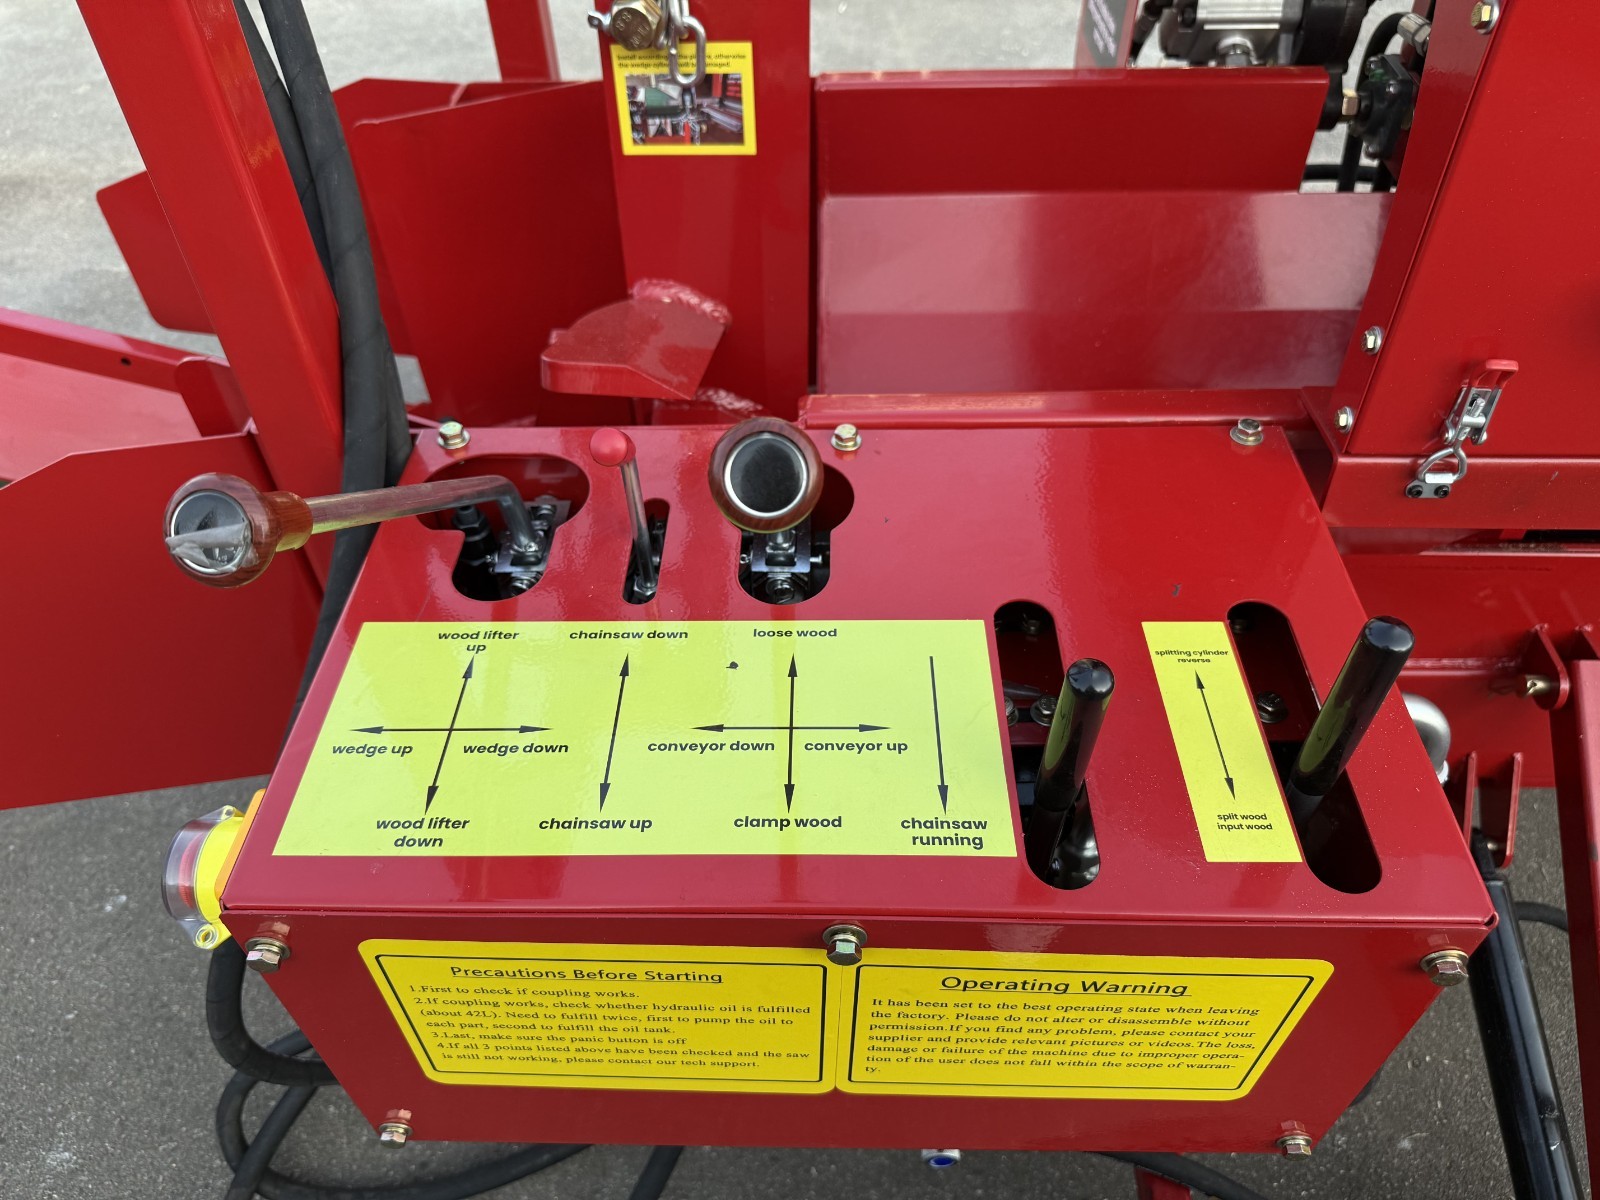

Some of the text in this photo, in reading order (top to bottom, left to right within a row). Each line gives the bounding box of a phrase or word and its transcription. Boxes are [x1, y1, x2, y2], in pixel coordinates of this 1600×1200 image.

[438, 630, 520, 640] wood lifter
[569, 629, 688, 639] chainsaw down
[753, 628, 837, 638] loose wood
[466, 644, 487, 654] up
[1154, 649, 1228, 657] splitting cylinder
[332, 743, 413, 758] wedge up
[463, 742, 569, 757] wedge down
[647, 740, 775, 754] conveyor down
[804, 742, 908, 754] conveyor up
[376, 816, 470, 829] wood lifter
[733, 815, 842, 832] clamp wood
[900, 816, 988, 830] chainsaw
[1216, 812, 1268, 822] split wood
[538, 816, 652, 832] chainsaw up
[1216, 822, 1273, 832] input wood
[393, 835, 443, 847] down
[911, 832, 984, 850] running
[450, 966, 722, 983] Precautions Before Starting
[455, 986, 470, 994] to
[473, 986, 513, 995] check
[516, 987, 528, 995] if
[531, 988, 591, 998] coupling
[942, 976, 1188, 997] Operating Warning
[441, 998, 501, 1008] coupling
[552, 1000, 591, 1009] check
[594, 1001, 648, 1010] whether
[652, 1002, 715, 1012] hydraulic
[718, 1004, 736, 1012] oil
[741, 1004, 752, 1012] is
[757, 1005, 810, 1014] fulfilled
[871, 998, 883, 1006] It
[887, 998, 910, 1007] has
[915, 999, 948, 1008] been
[996, 1001, 1018, 1010] the
[1022, 1002, 1051, 1010] best
[1055, 1004, 1123, 1014] operating
[1165, 1005, 1203, 1014] when
[1206, 1006, 1260, 1016] leaving
[420, 1008, 462, 1016] (about
[504, 1011, 540, 1019] Need
[543, 1012, 556, 1020] to
[560, 1012, 598, 1020] fulfill
[646, 1014, 673, 1022] first
[693, 1017, 730, 1025] pump
[734, 1016, 755, 1024] the
[758, 1017, 776, 1025] oil
[870, 1010, 892, 1018] the
[954, 1012, 999, 1021] Please
[1003, 1013, 1021, 1022] do
[1025, 1015, 1049, 1023] not
[1052, 1015, 1085, 1023] alter
[1106, 1016, 1192, 1025] disassemble
[1196, 1018, 1250, 1026] without
[425, 1020, 456, 1028] each
[492, 1022, 537, 1030] second
[556, 1023, 594, 1032] fulfill
[598, 1024, 618, 1032] the
[622, 1025, 640, 1033] oil
[994, 1025, 1023, 1033] find
[1026, 1027, 1052, 1035] any
[1120, 1028, 1165, 1037] please
[478, 1032, 512, 1040] make
[546, 1034, 566, 1042] the
[569, 1035, 604, 1043] panic
[606, 1035, 649, 1044] button
[652, 1036, 664, 1044] is
[666, 1037, 687, 1045] off
[868, 1034, 923, 1043] supplier
[954, 1036, 1007, 1044] provide
[1011, 1037, 1066, 1045] relevant
[1069, 1038, 1124, 1047] pictures
[463, 1042, 480, 1050] all
[493, 1043, 533, 1052] points
[535, 1044, 571, 1052] listed
[574, 1045, 611, 1053] above
[614, 1046, 644, 1054] have
[647, 1047, 678, 1055] been
[681, 1048, 732, 1056] checked
[762, 1050, 782, 1058] the
[866, 1044, 918, 1054] damage
[941, 1046, 985, 1054] failure
[1031, 1048, 1088, 1056] machine
[1091, 1049, 1116, 1057] due
[1137, 1050, 1199, 1059] improper
[456, 1052, 480, 1060] still
[565, 1055, 604, 1064] please
[895, 1055, 912, 1063] of
[969, 1057, 999, 1065] does
[1029, 1058, 1052, 1066] fall
[1056, 1059, 1097, 1067] within
